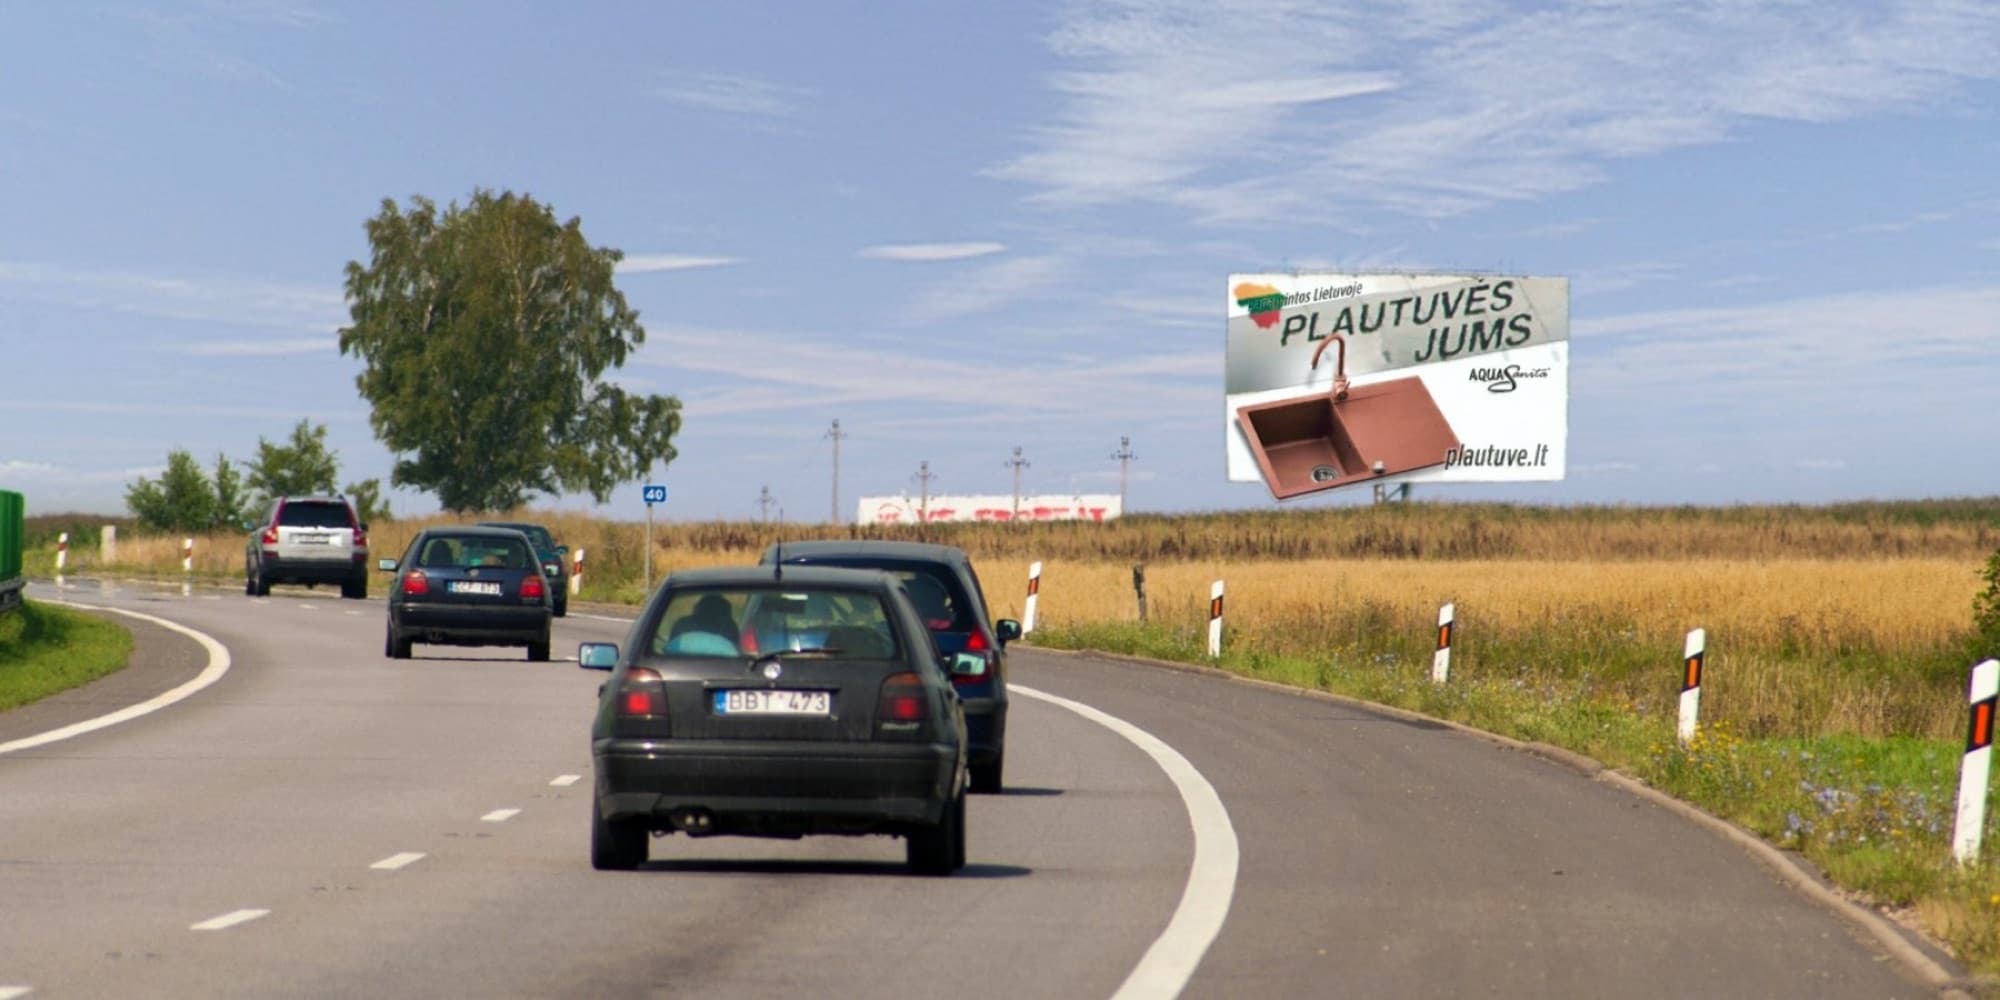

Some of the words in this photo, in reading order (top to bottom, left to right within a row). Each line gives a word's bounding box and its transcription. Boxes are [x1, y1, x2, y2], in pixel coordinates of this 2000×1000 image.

[1248, 291, 1312, 314] intos
[1313, 281, 1363, 301] Lietuvoje
[1280, 278, 1514, 346] PLAUTUVĖS
[1414, 313, 1532, 362] JUMS
[1444, 443, 1549, 470] plautuve.lt
[646, 488, 664, 500] 40
[728, 691, 772, 711] BBT
[788, 691, 826, 712] 473
